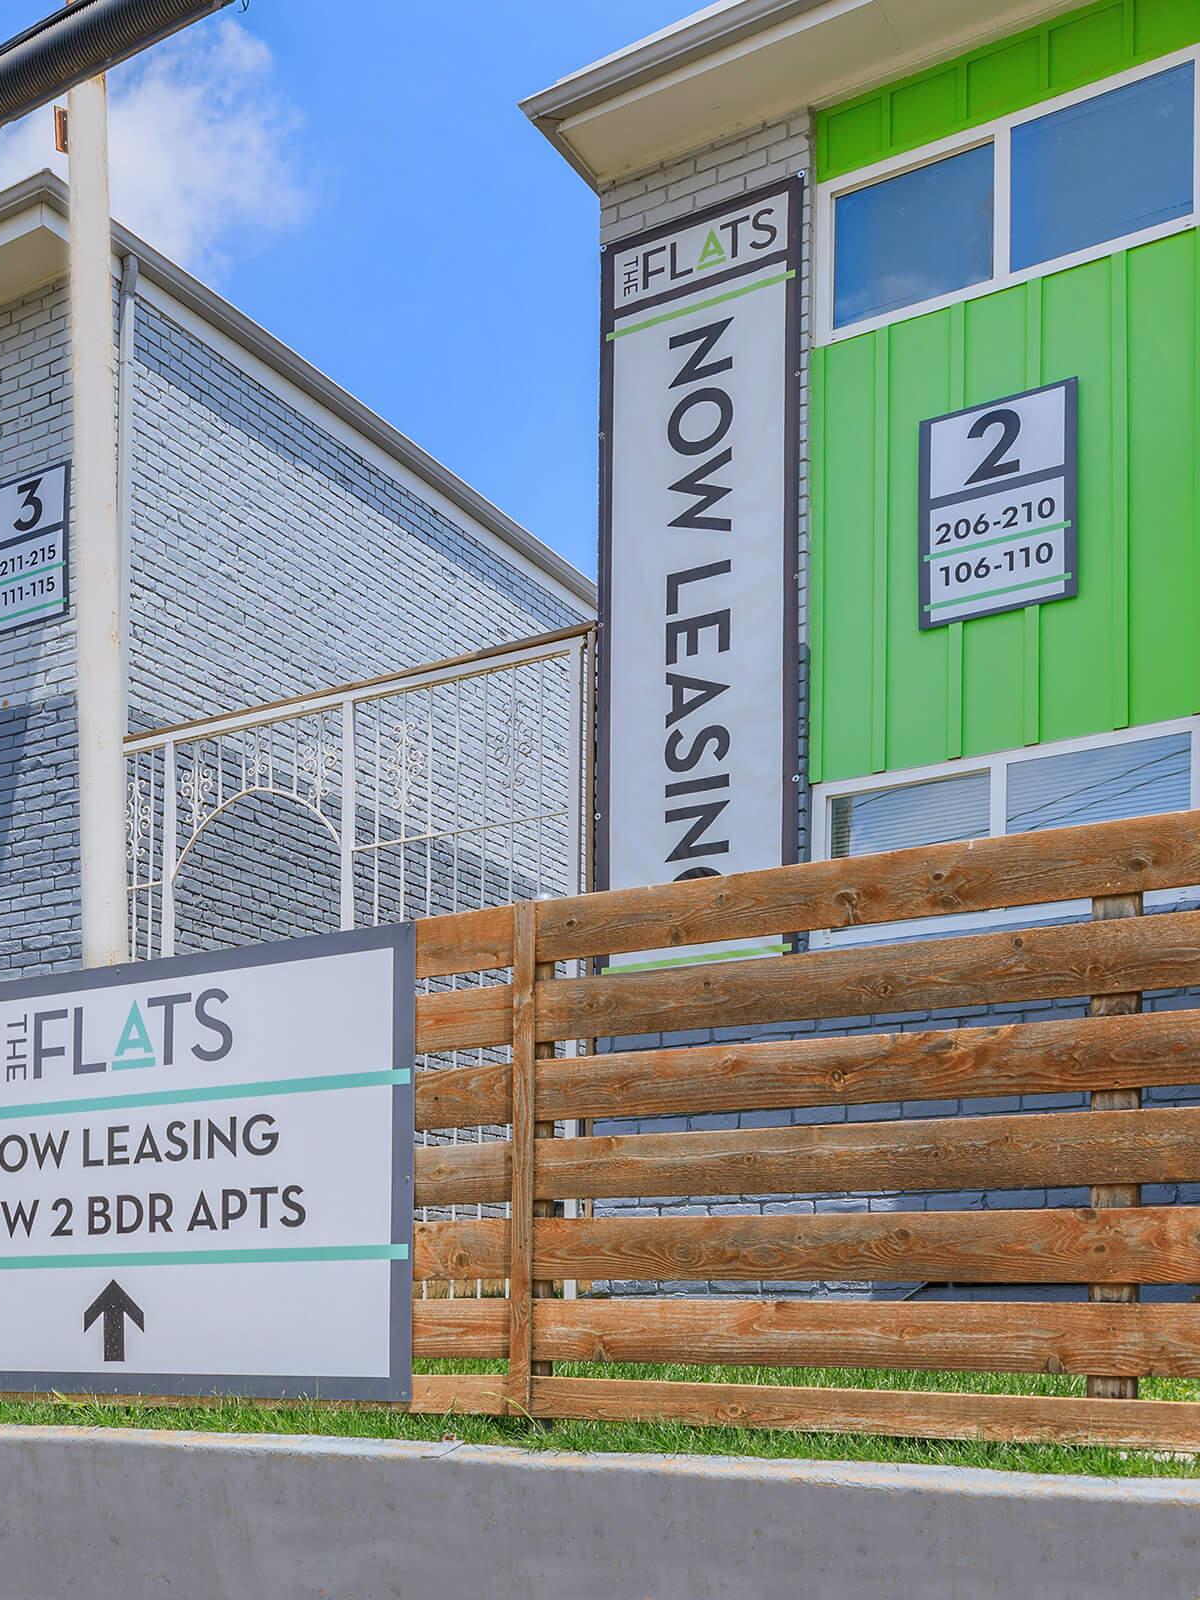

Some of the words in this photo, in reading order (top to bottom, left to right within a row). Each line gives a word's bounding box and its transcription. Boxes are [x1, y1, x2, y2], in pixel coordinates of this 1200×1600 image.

[623, 255, 639, 297] THE
[642, 208, 778, 290] FLATS
[667, 317, 734, 532] NOW
[964, 408, 1021, 486] 2
[13, 477, 43, 532] 3
[935, 497, 1056, 545] 206-210
[0, 544, 56, 576] 211-215
[939, 542, 1054, 587] 106-110
[2, 576, 55, 606] 111-115
[664, 559, 732, 882] LEASIN
[6, 1014, 27, 1082] THE
[33, 988, 233, 1080] FLATS
[82, 1114, 279, 1168] LEASING
[50, 1198, 74, 1237] 2
[87, 1192, 173, 1236] BDR
[187, 1185, 307, 1232] APTS
